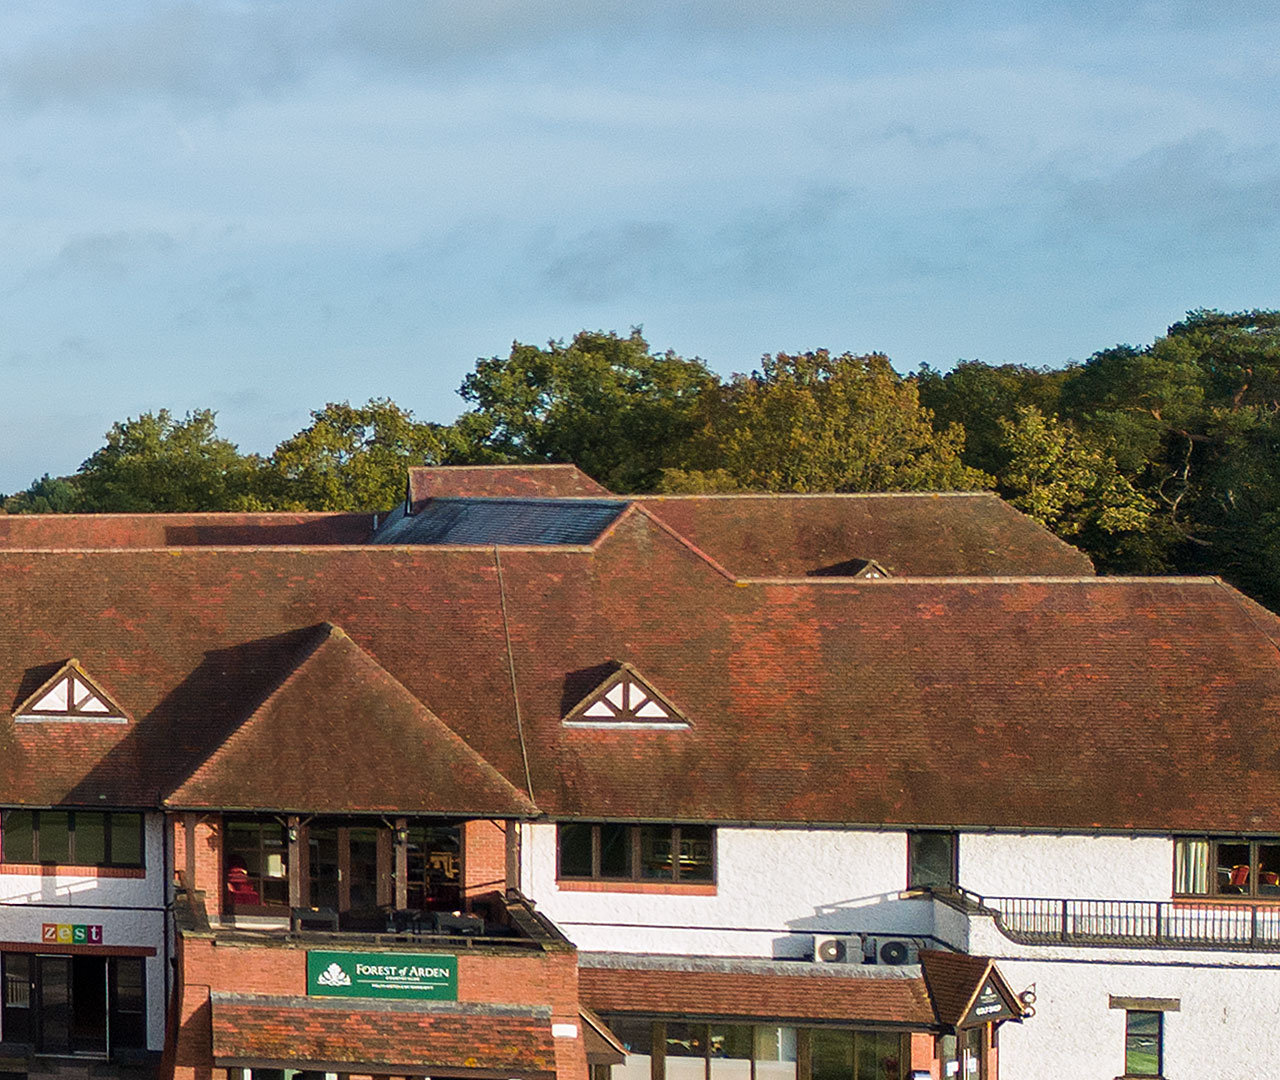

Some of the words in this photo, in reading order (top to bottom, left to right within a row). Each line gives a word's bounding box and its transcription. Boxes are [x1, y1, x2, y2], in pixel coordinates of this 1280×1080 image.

[356, 963, 397, 976] FOREST
[398, 966, 408, 977] of
[408, 966, 450, 978] ARDEN
